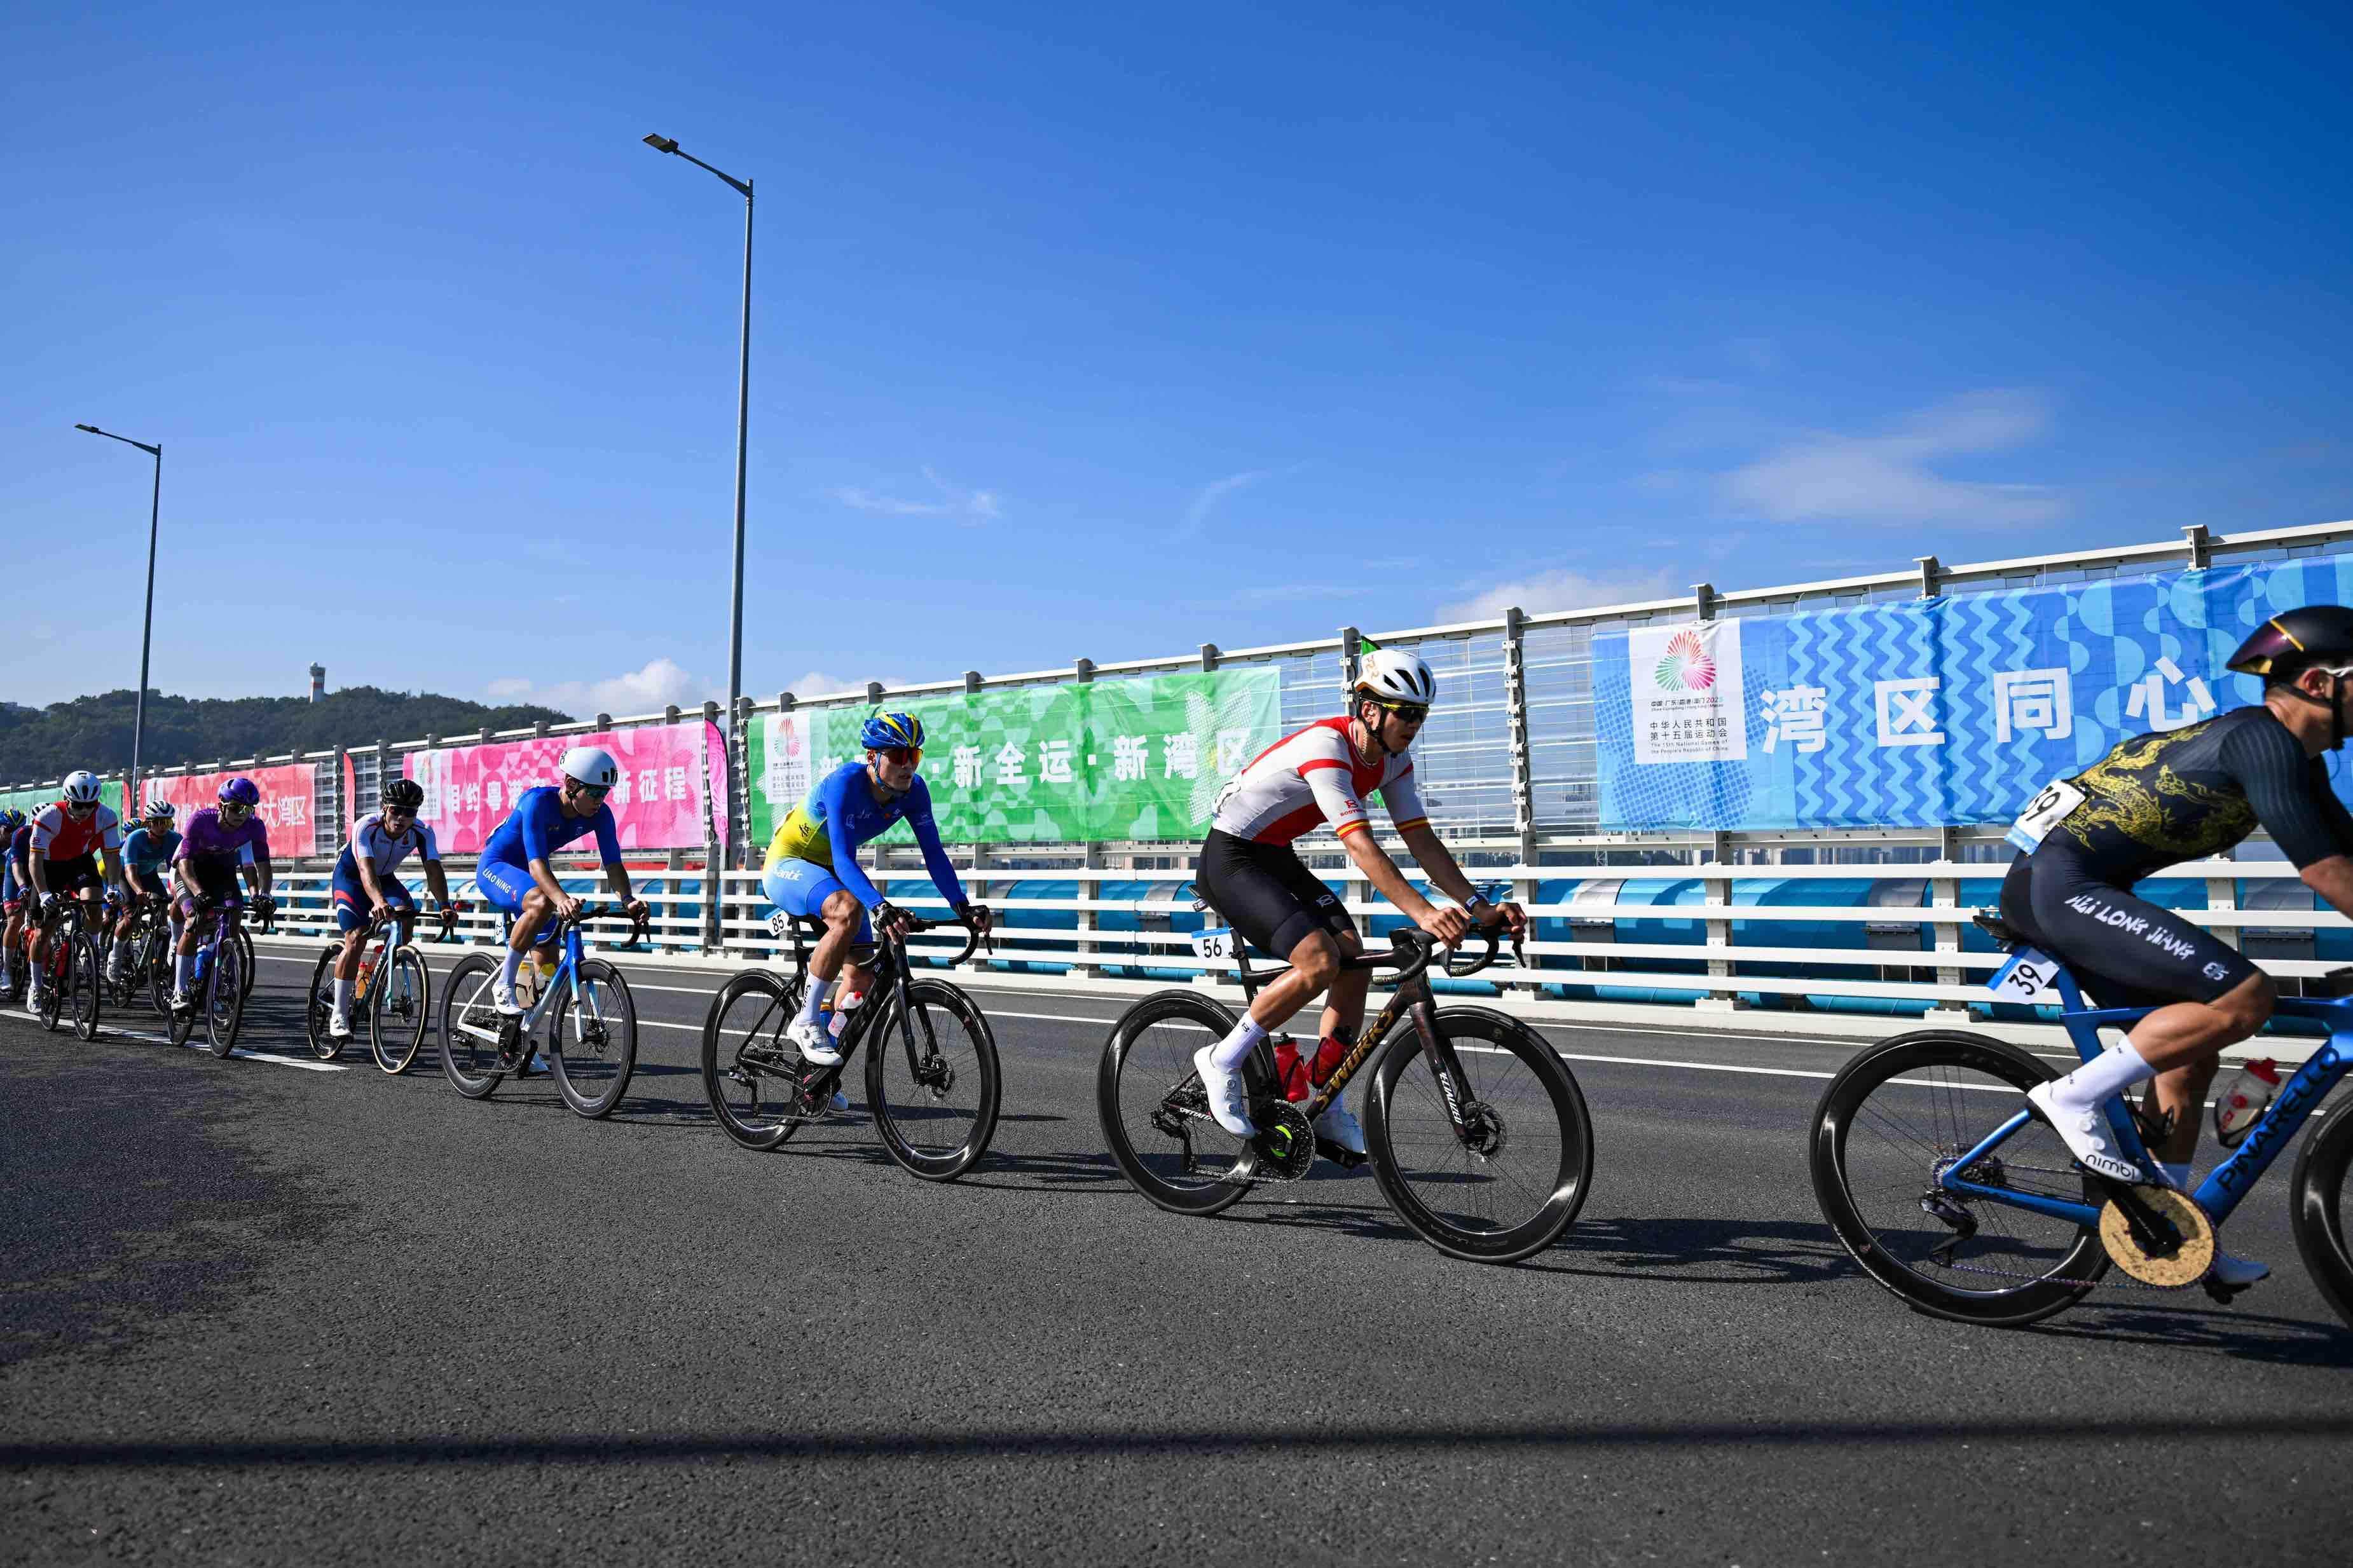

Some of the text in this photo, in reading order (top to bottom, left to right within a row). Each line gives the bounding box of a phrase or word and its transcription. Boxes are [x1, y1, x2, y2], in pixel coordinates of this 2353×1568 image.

[1760, 655, 2217, 754] 湾区同心
[1650, 717, 1727, 730] 中华人民共和国
[1650, 728, 1727, 741] 第十五届运动会
[483, 868, 511, 894] LIAO NING
[772, 914, 784, 932] 85
[2094, 905, 2149, 935] LONG
[1203, 937, 1222, 958] 56
[2008, 964, 2043, 995] 39
[1439, 1072, 1463, 1124] ECIALIZED
[2085, 1154, 2135, 1180] nimbl
